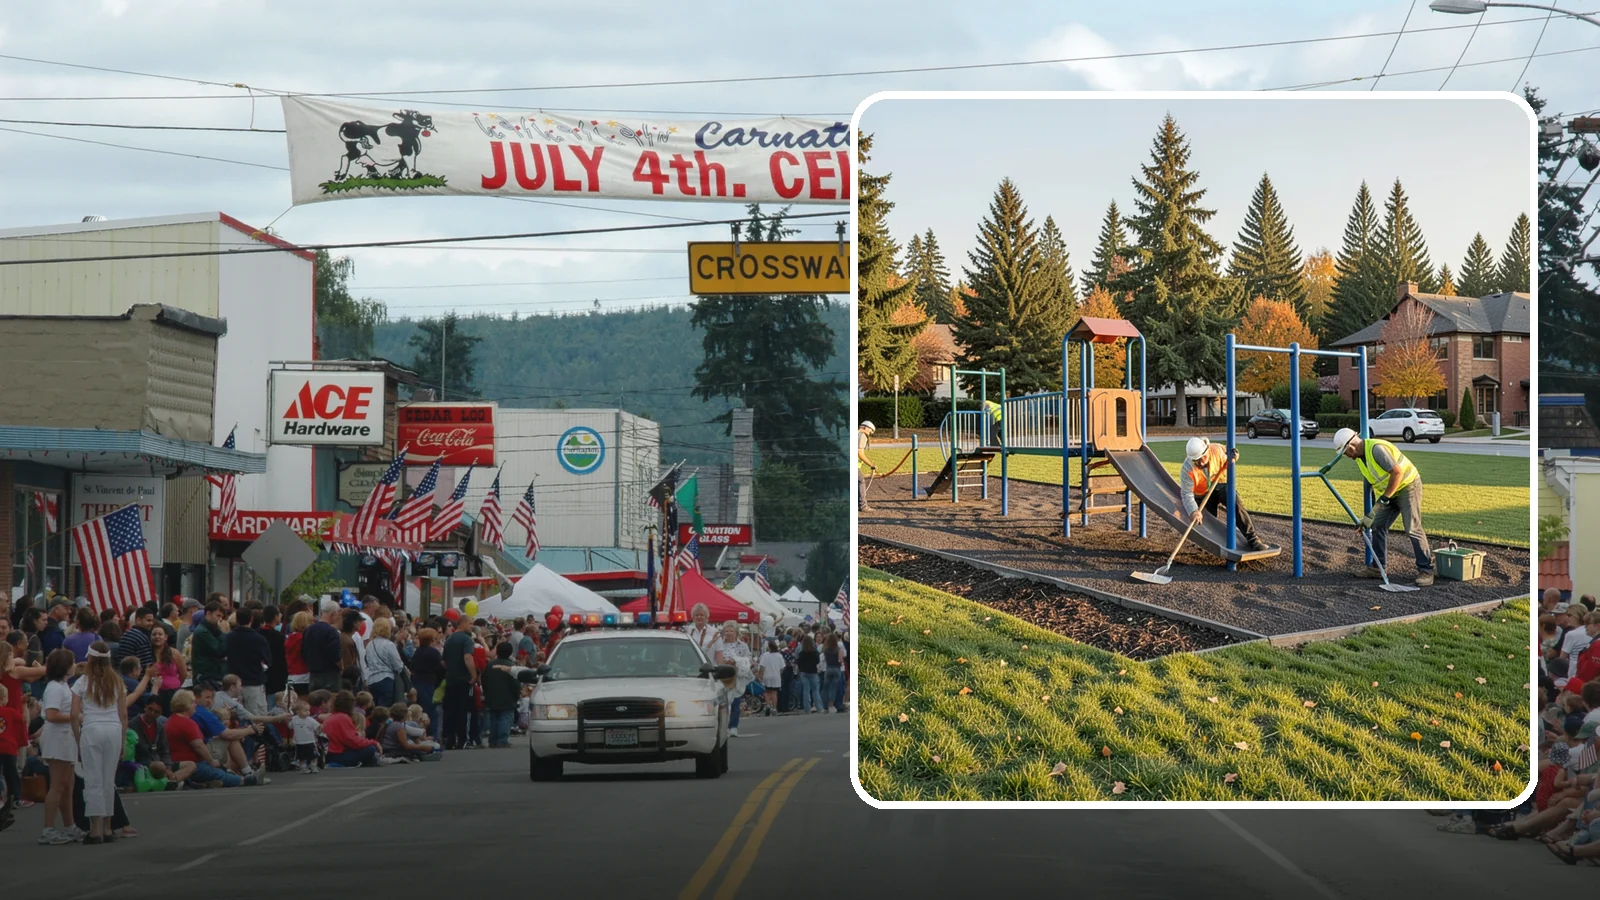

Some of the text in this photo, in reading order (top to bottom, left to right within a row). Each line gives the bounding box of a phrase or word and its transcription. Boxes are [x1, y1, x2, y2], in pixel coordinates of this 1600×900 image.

[481, 141, 604, 193] JULY
[632, 150, 746, 198] 4th.
[697, 254, 850, 280] CROSSWA
[283, 380, 373, 420] ACE
[405, 410, 453, 422] CEDAR
[283, 421, 371, 436] Hardware
[416, 428, 477, 447] Coca-Cola
[354, 467, 385, 480] Simpl
[83, 484, 155, 495] St. Vincent de Paul
[688, 526, 741, 535] CRNATION
[699, 535, 730, 543] GLASS
